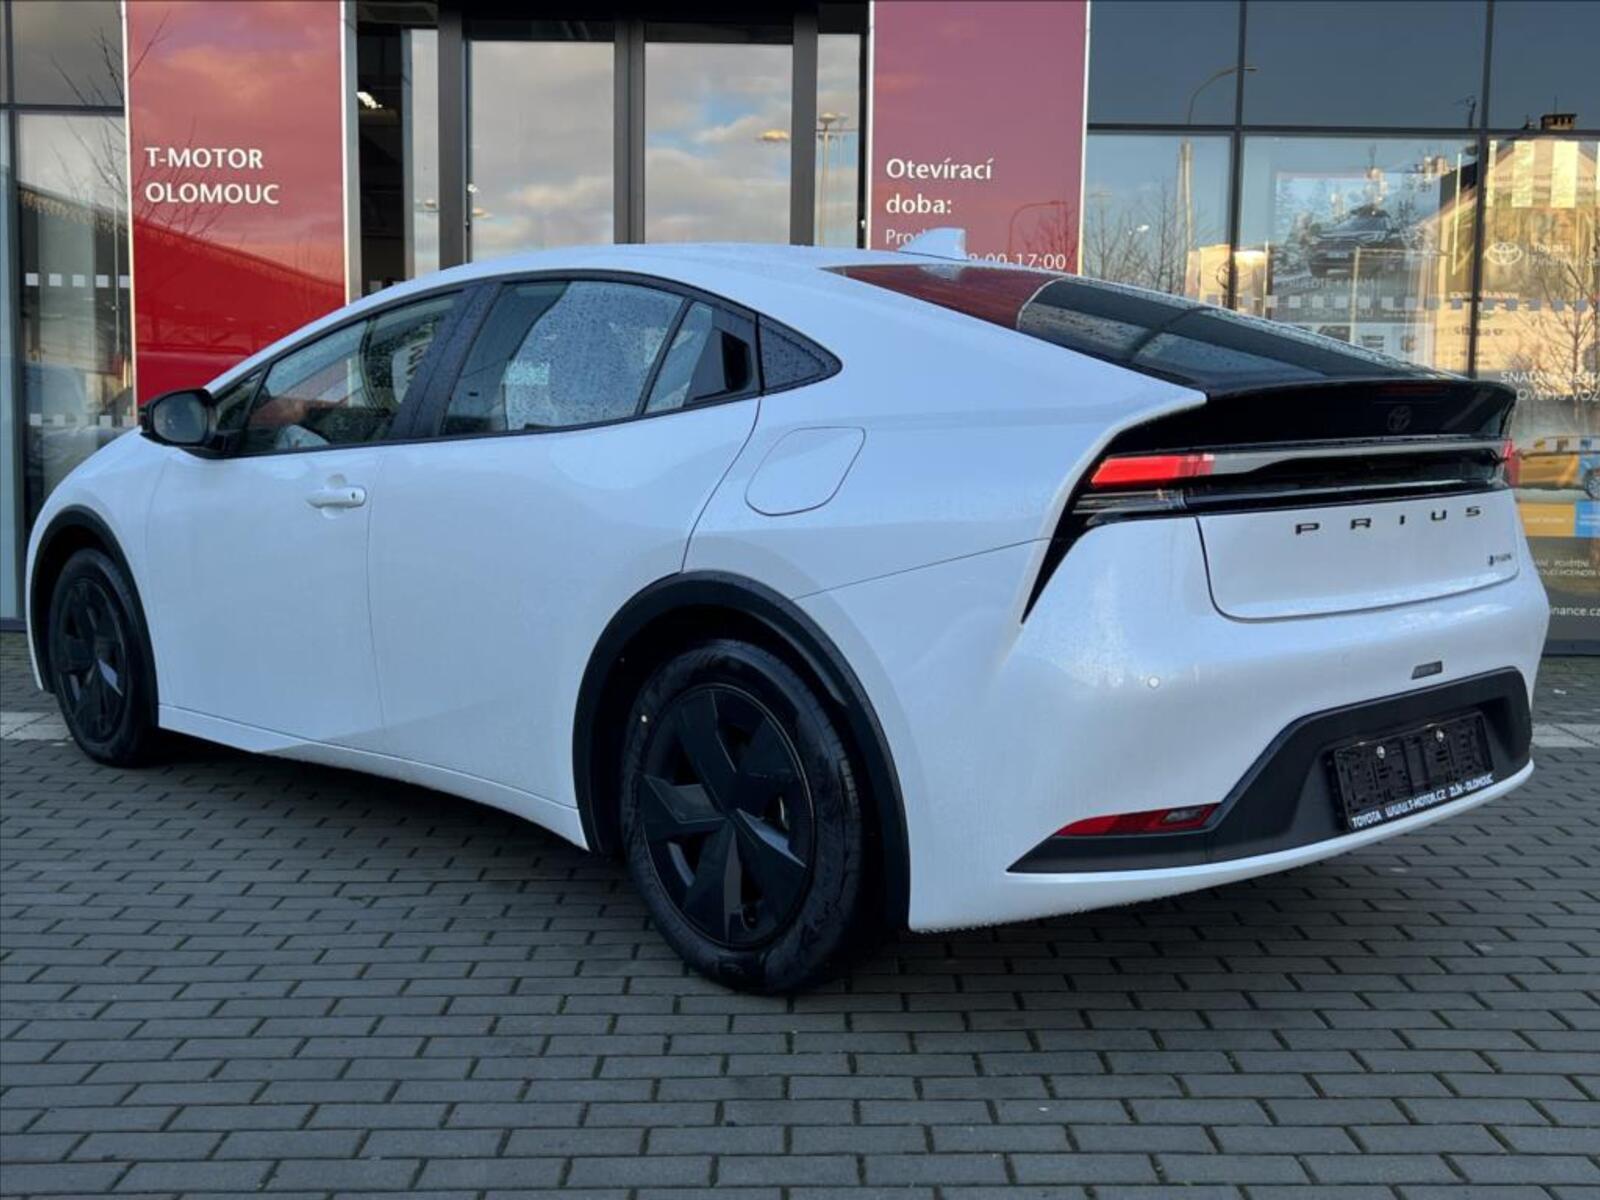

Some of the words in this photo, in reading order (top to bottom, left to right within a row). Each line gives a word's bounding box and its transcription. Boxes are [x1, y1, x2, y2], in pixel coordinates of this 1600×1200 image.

[144, 147, 263, 169] T-MOTOR
[886, 157, 994, 180] Otevírací
[145, 182, 280, 205] OLOMOUC
[886, 193, 952, 214] doba:
[1295, 505, 1481, 535] PRIUS
[1352, 810, 1383, 828] TOYOTA
